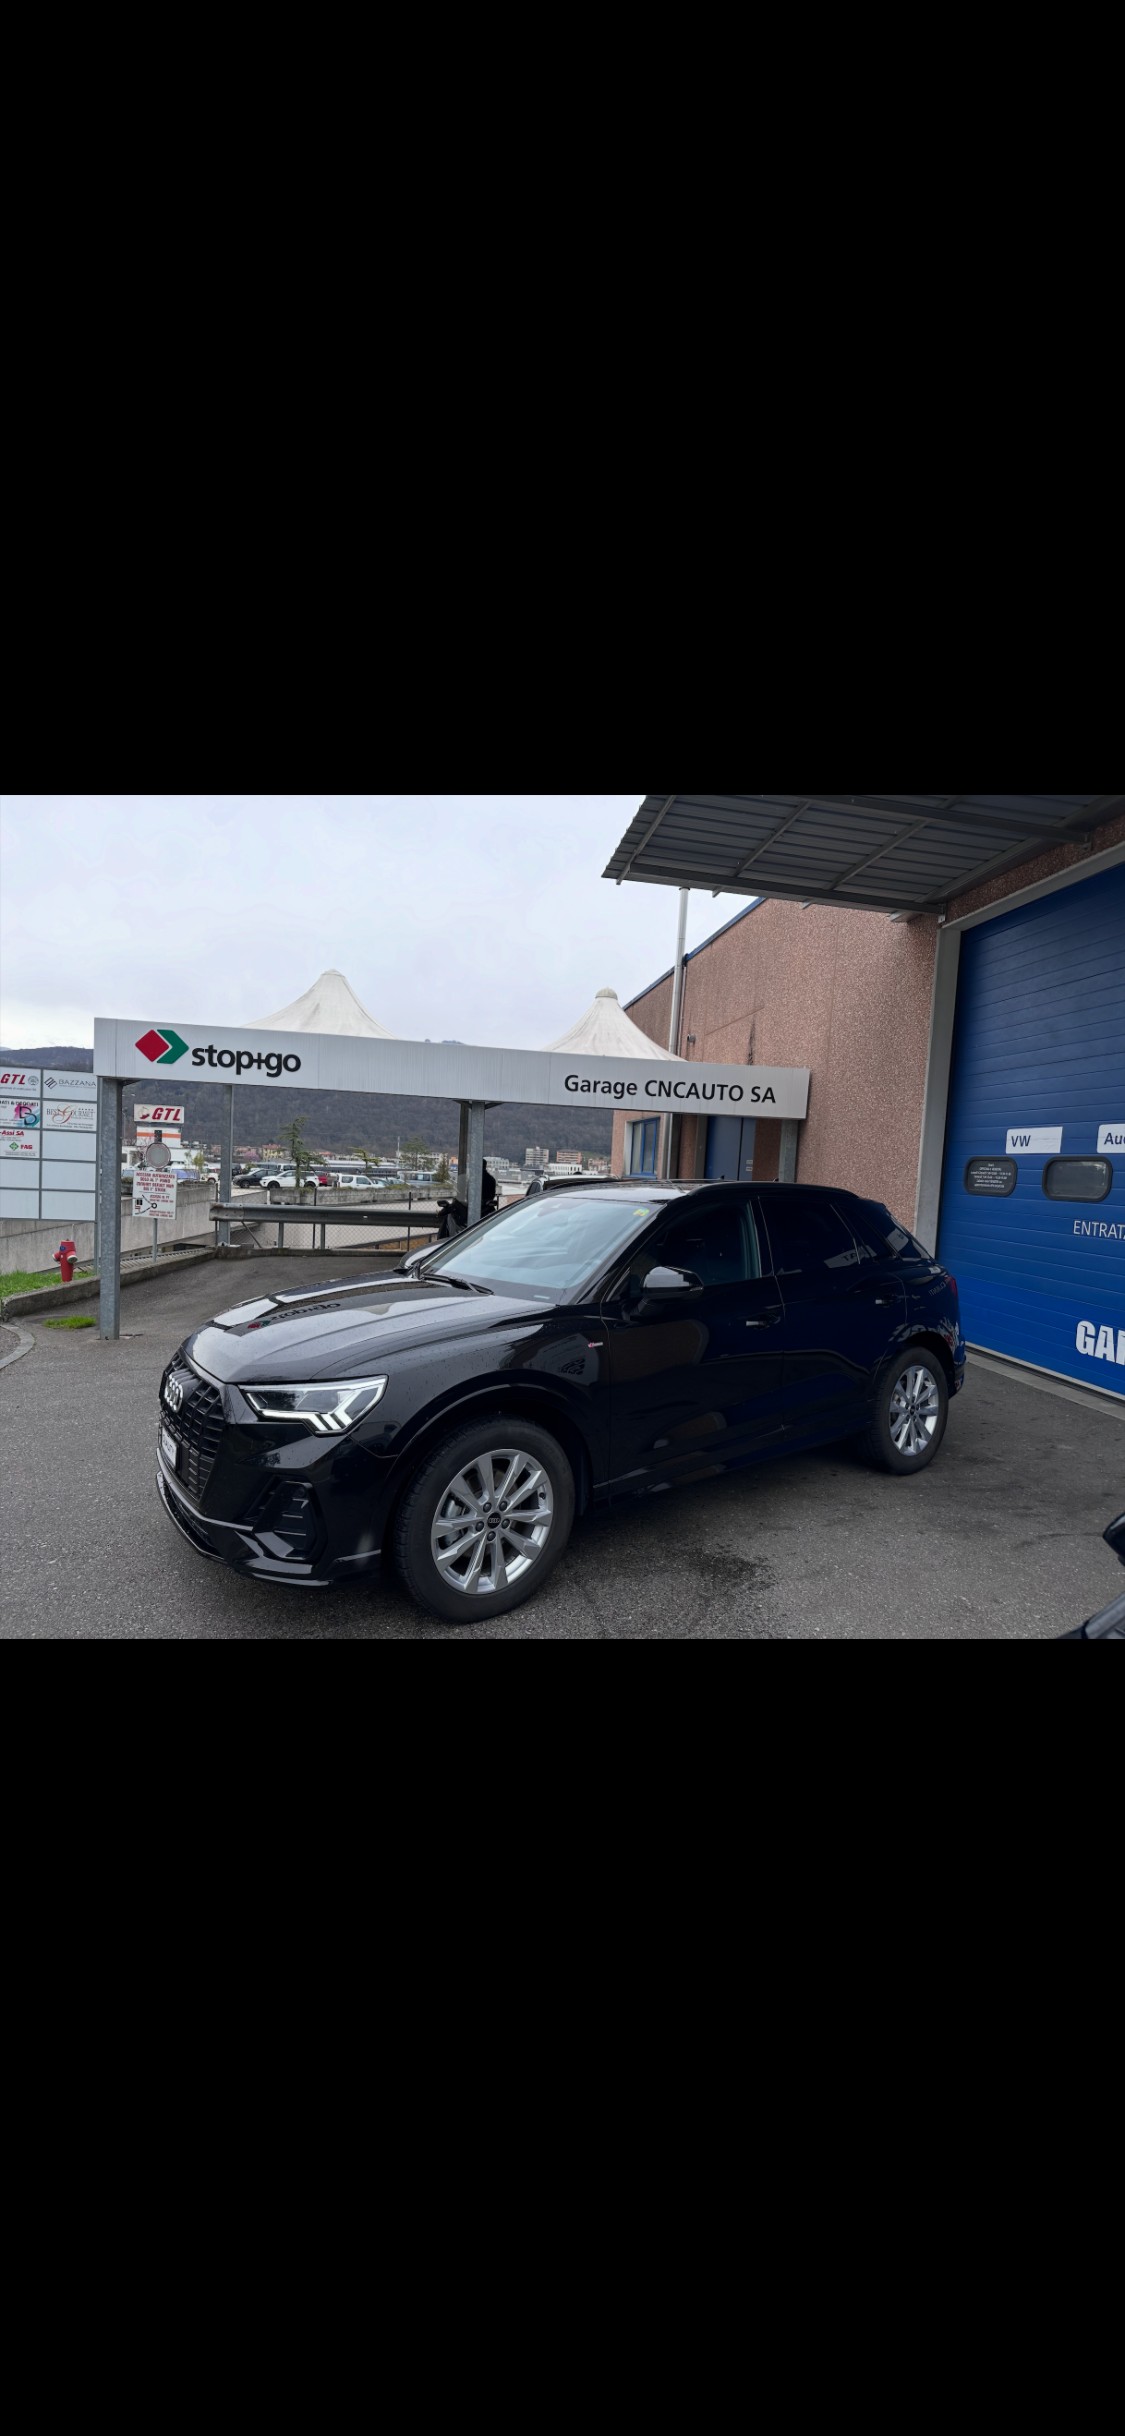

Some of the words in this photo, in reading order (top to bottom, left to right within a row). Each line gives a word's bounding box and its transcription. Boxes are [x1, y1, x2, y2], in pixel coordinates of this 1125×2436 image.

[192, 1044, 301, 1078] stop+go
[0, 1073, 26, 1085] GTL
[58, 1079, 96, 1087] BAZZANA
[564, 1074, 638, 1099] Garage
[644, 1080, 744, 1101] CNCAUTO
[750, 1086, 776, 1103] SA
[152, 1107, 181, 1121] GTL
[1010, 1134, 1032, 1147] VW
[1073, 1221, 1125, 1240] ENTRAT
